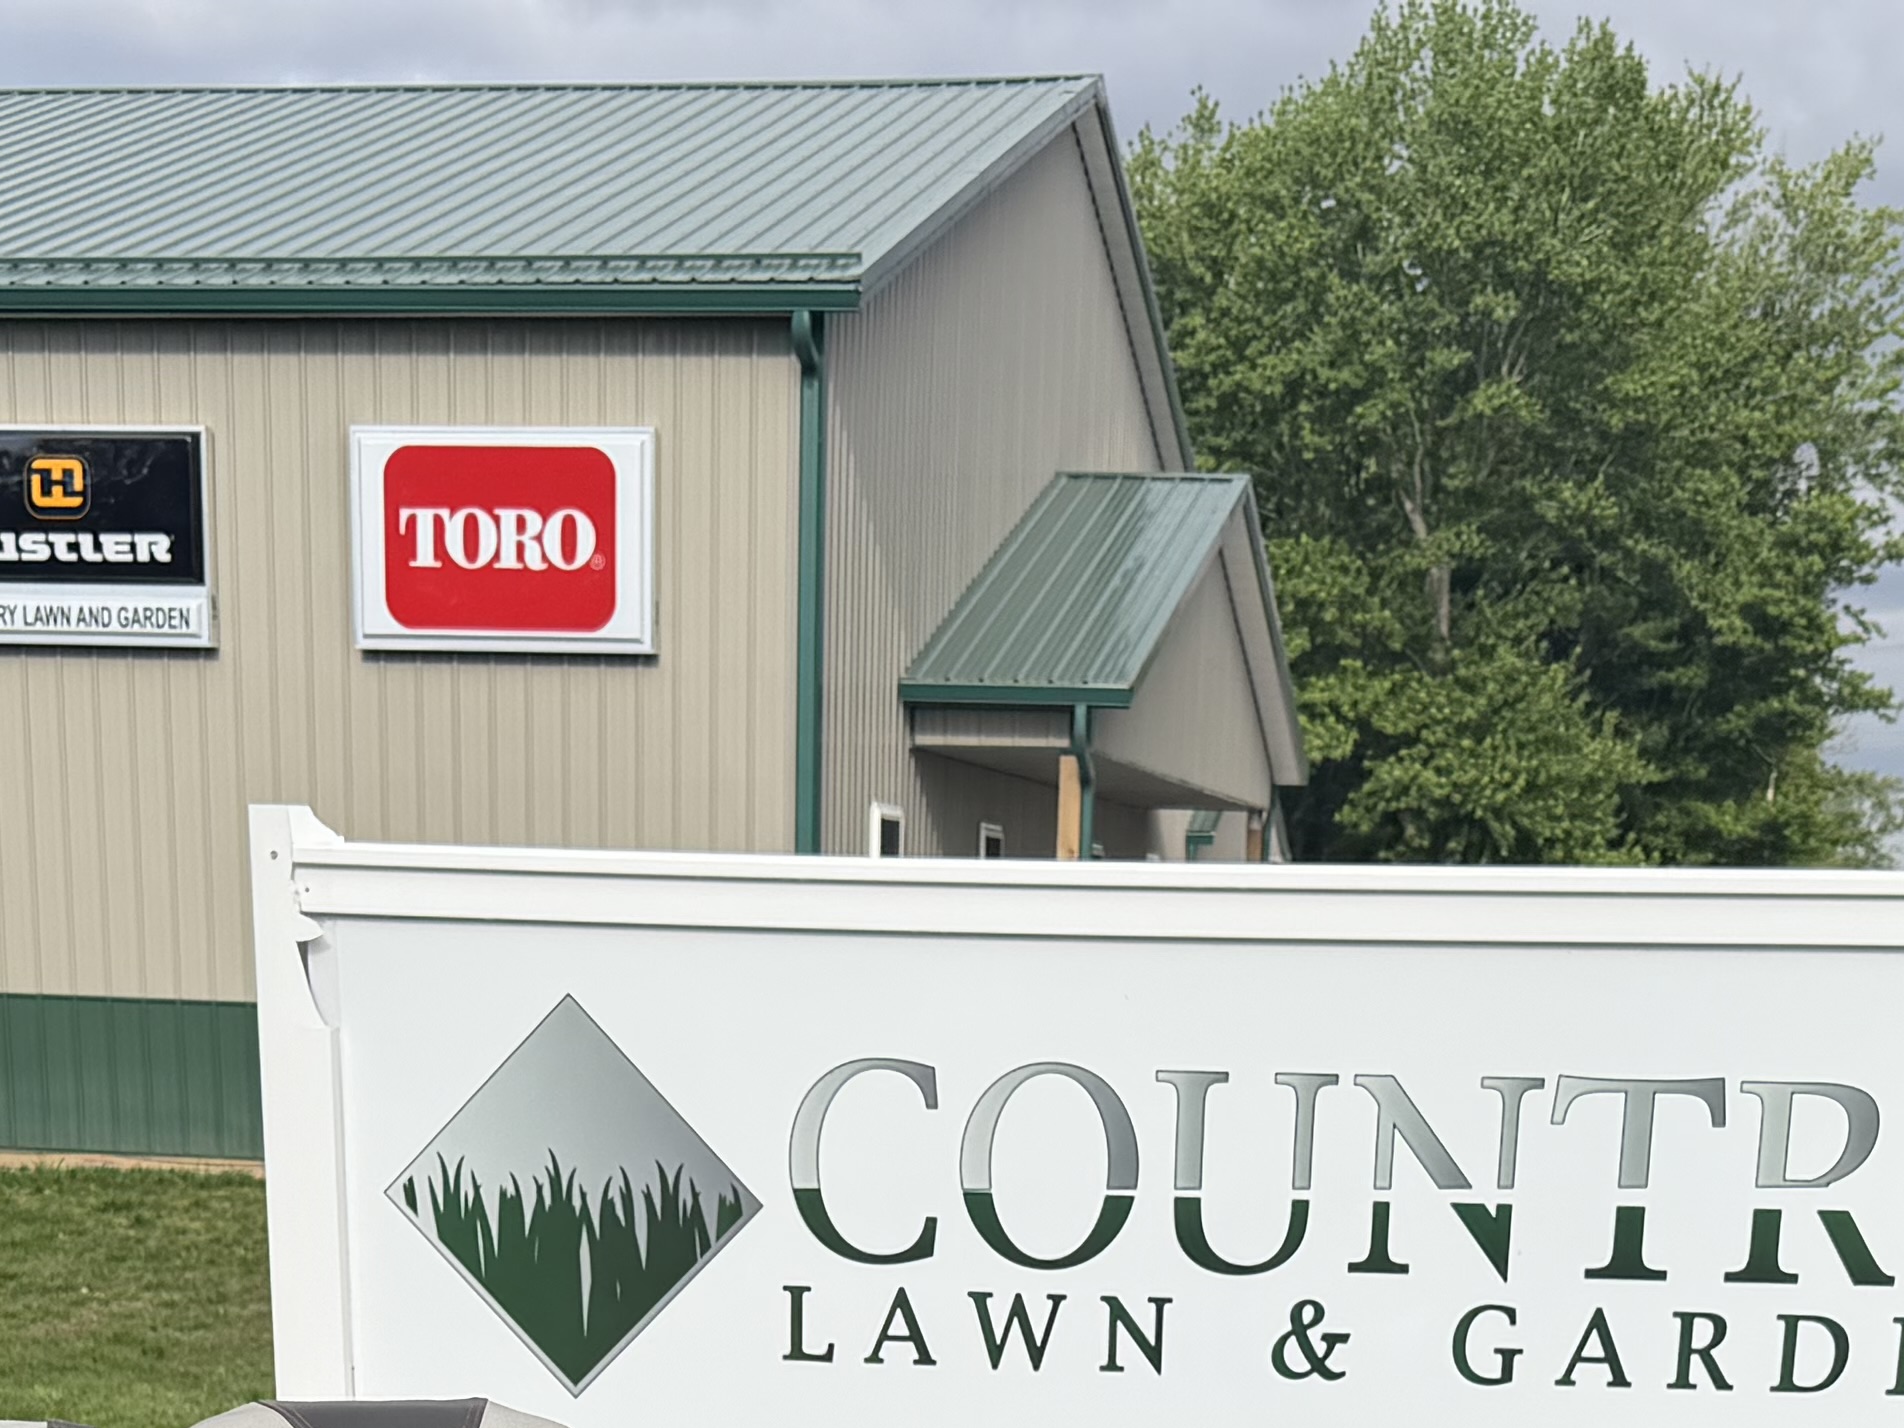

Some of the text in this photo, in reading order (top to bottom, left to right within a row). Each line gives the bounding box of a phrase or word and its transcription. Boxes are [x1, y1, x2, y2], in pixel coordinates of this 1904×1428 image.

[399, 506, 597, 570] TORO
[23, 604, 71, 627] LAWN
[76, 606, 112, 628] AND
[117, 607, 190, 630] GARDEN
[783, 1285, 1173, 1378] LAWN
[1271, 1300, 1350, 1384] &
